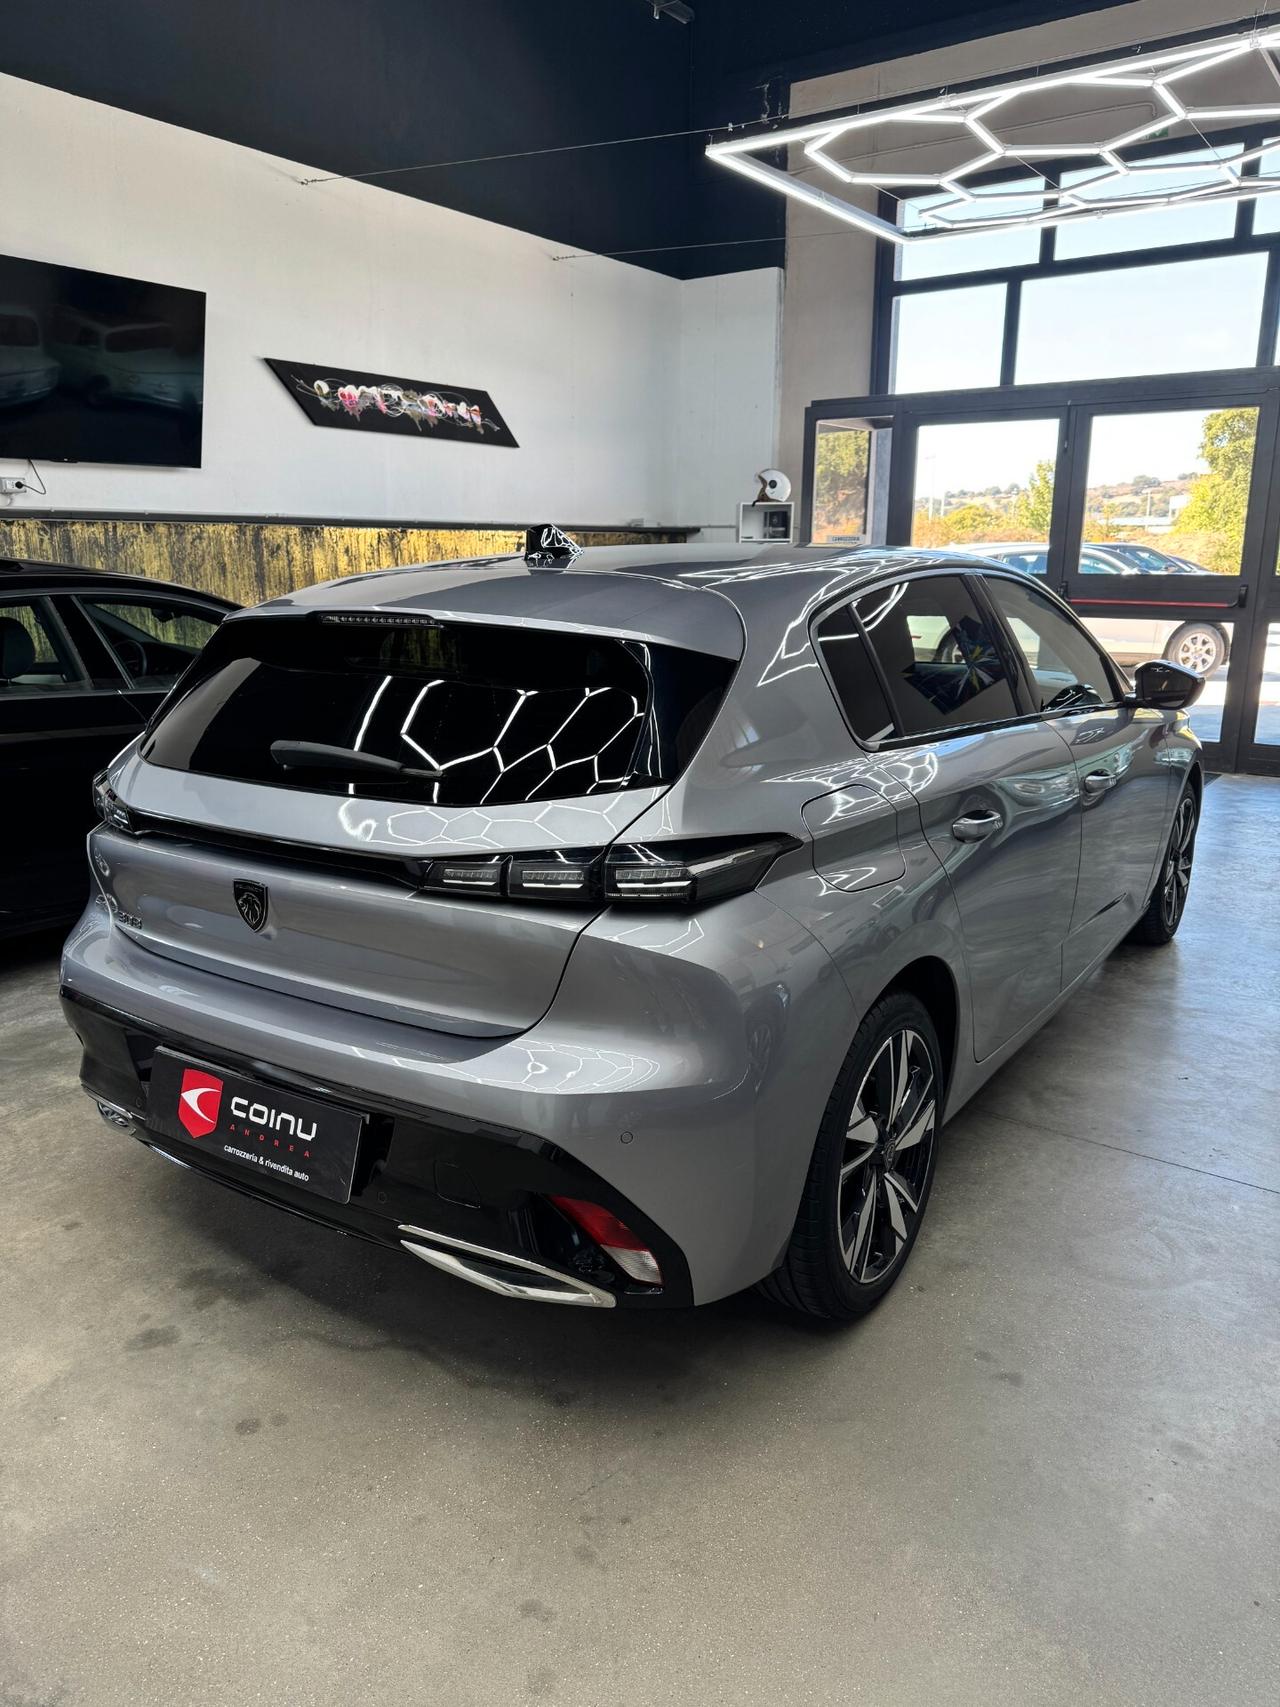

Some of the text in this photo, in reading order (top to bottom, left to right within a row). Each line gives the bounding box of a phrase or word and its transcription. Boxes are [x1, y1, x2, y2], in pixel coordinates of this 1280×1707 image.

[223, 1144, 309, 1182] carrozzeria & rivendita auto
